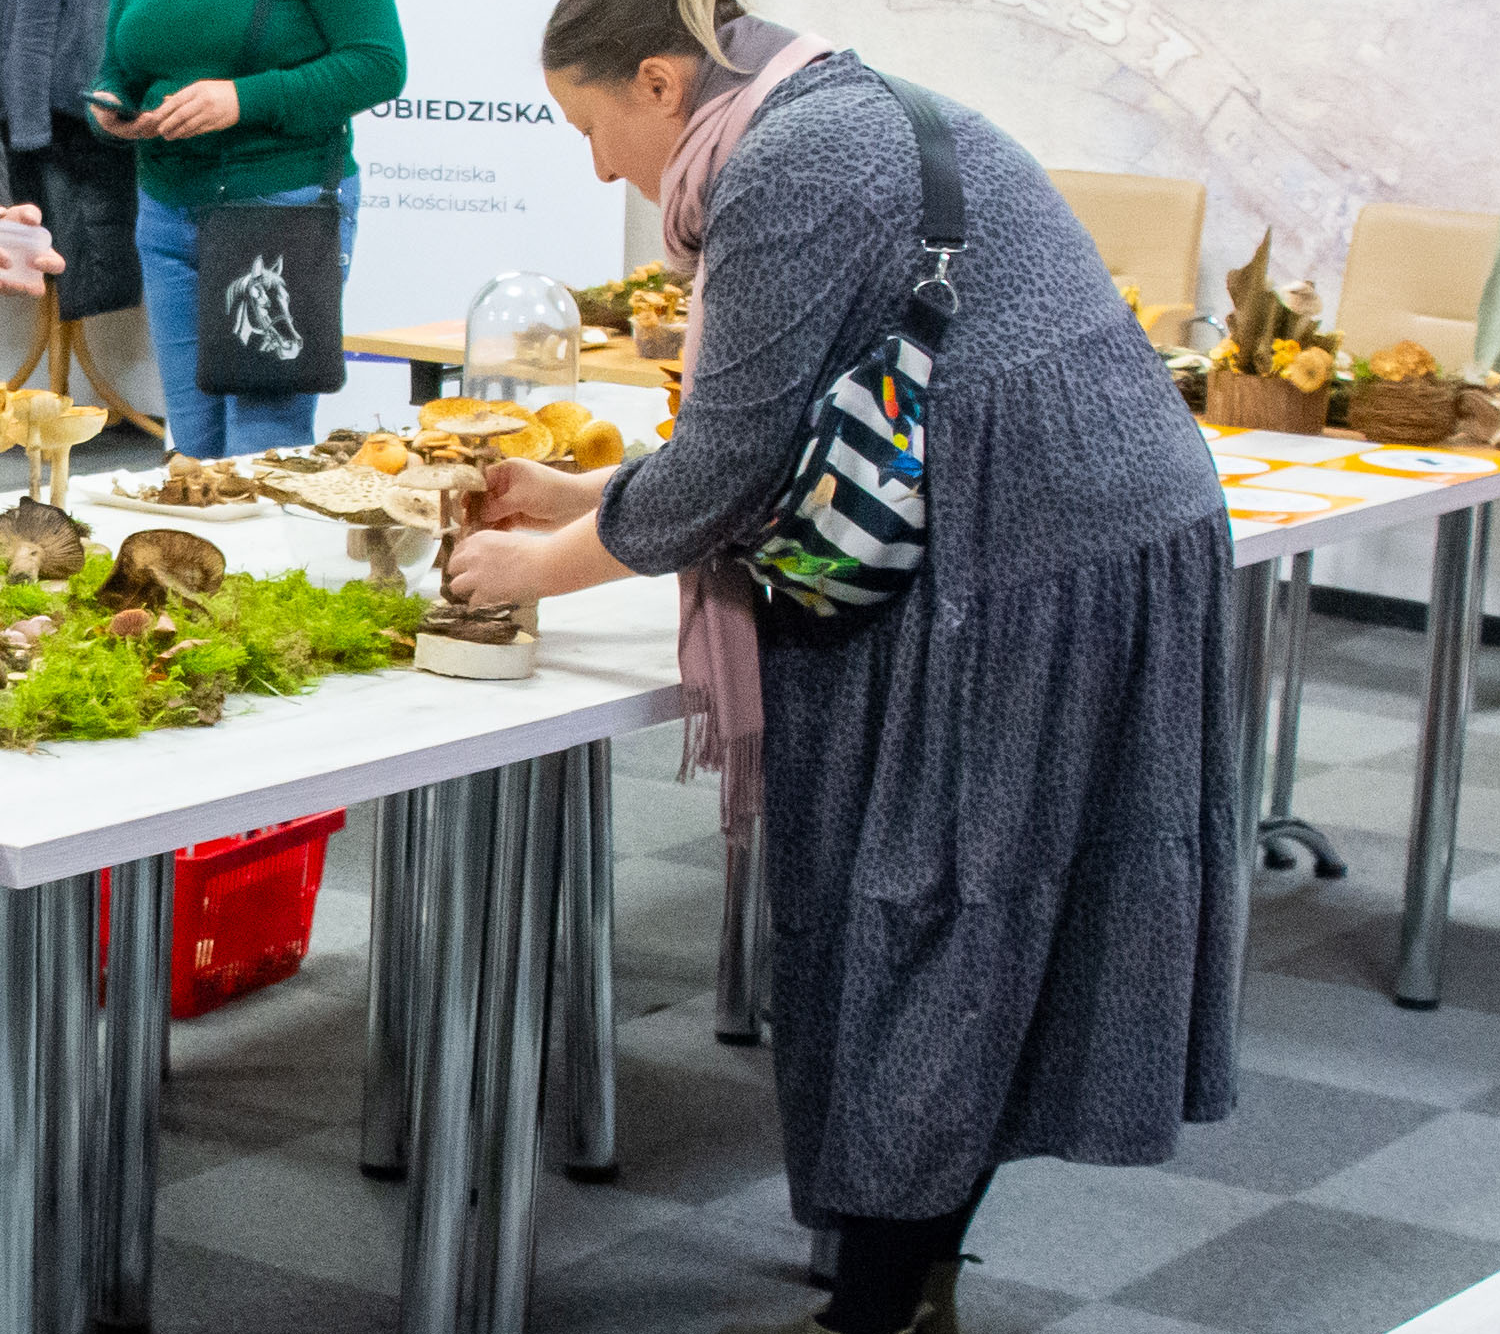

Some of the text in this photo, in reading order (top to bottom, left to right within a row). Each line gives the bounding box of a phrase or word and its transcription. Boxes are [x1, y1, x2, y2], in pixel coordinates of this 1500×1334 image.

[370, 98, 555, 124] OBIEDZISKA
[369, 162, 496, 183] Pobiedziska
[398, 194, 507, 212] Kościuszki
[514, 198, 526, 212] 4
